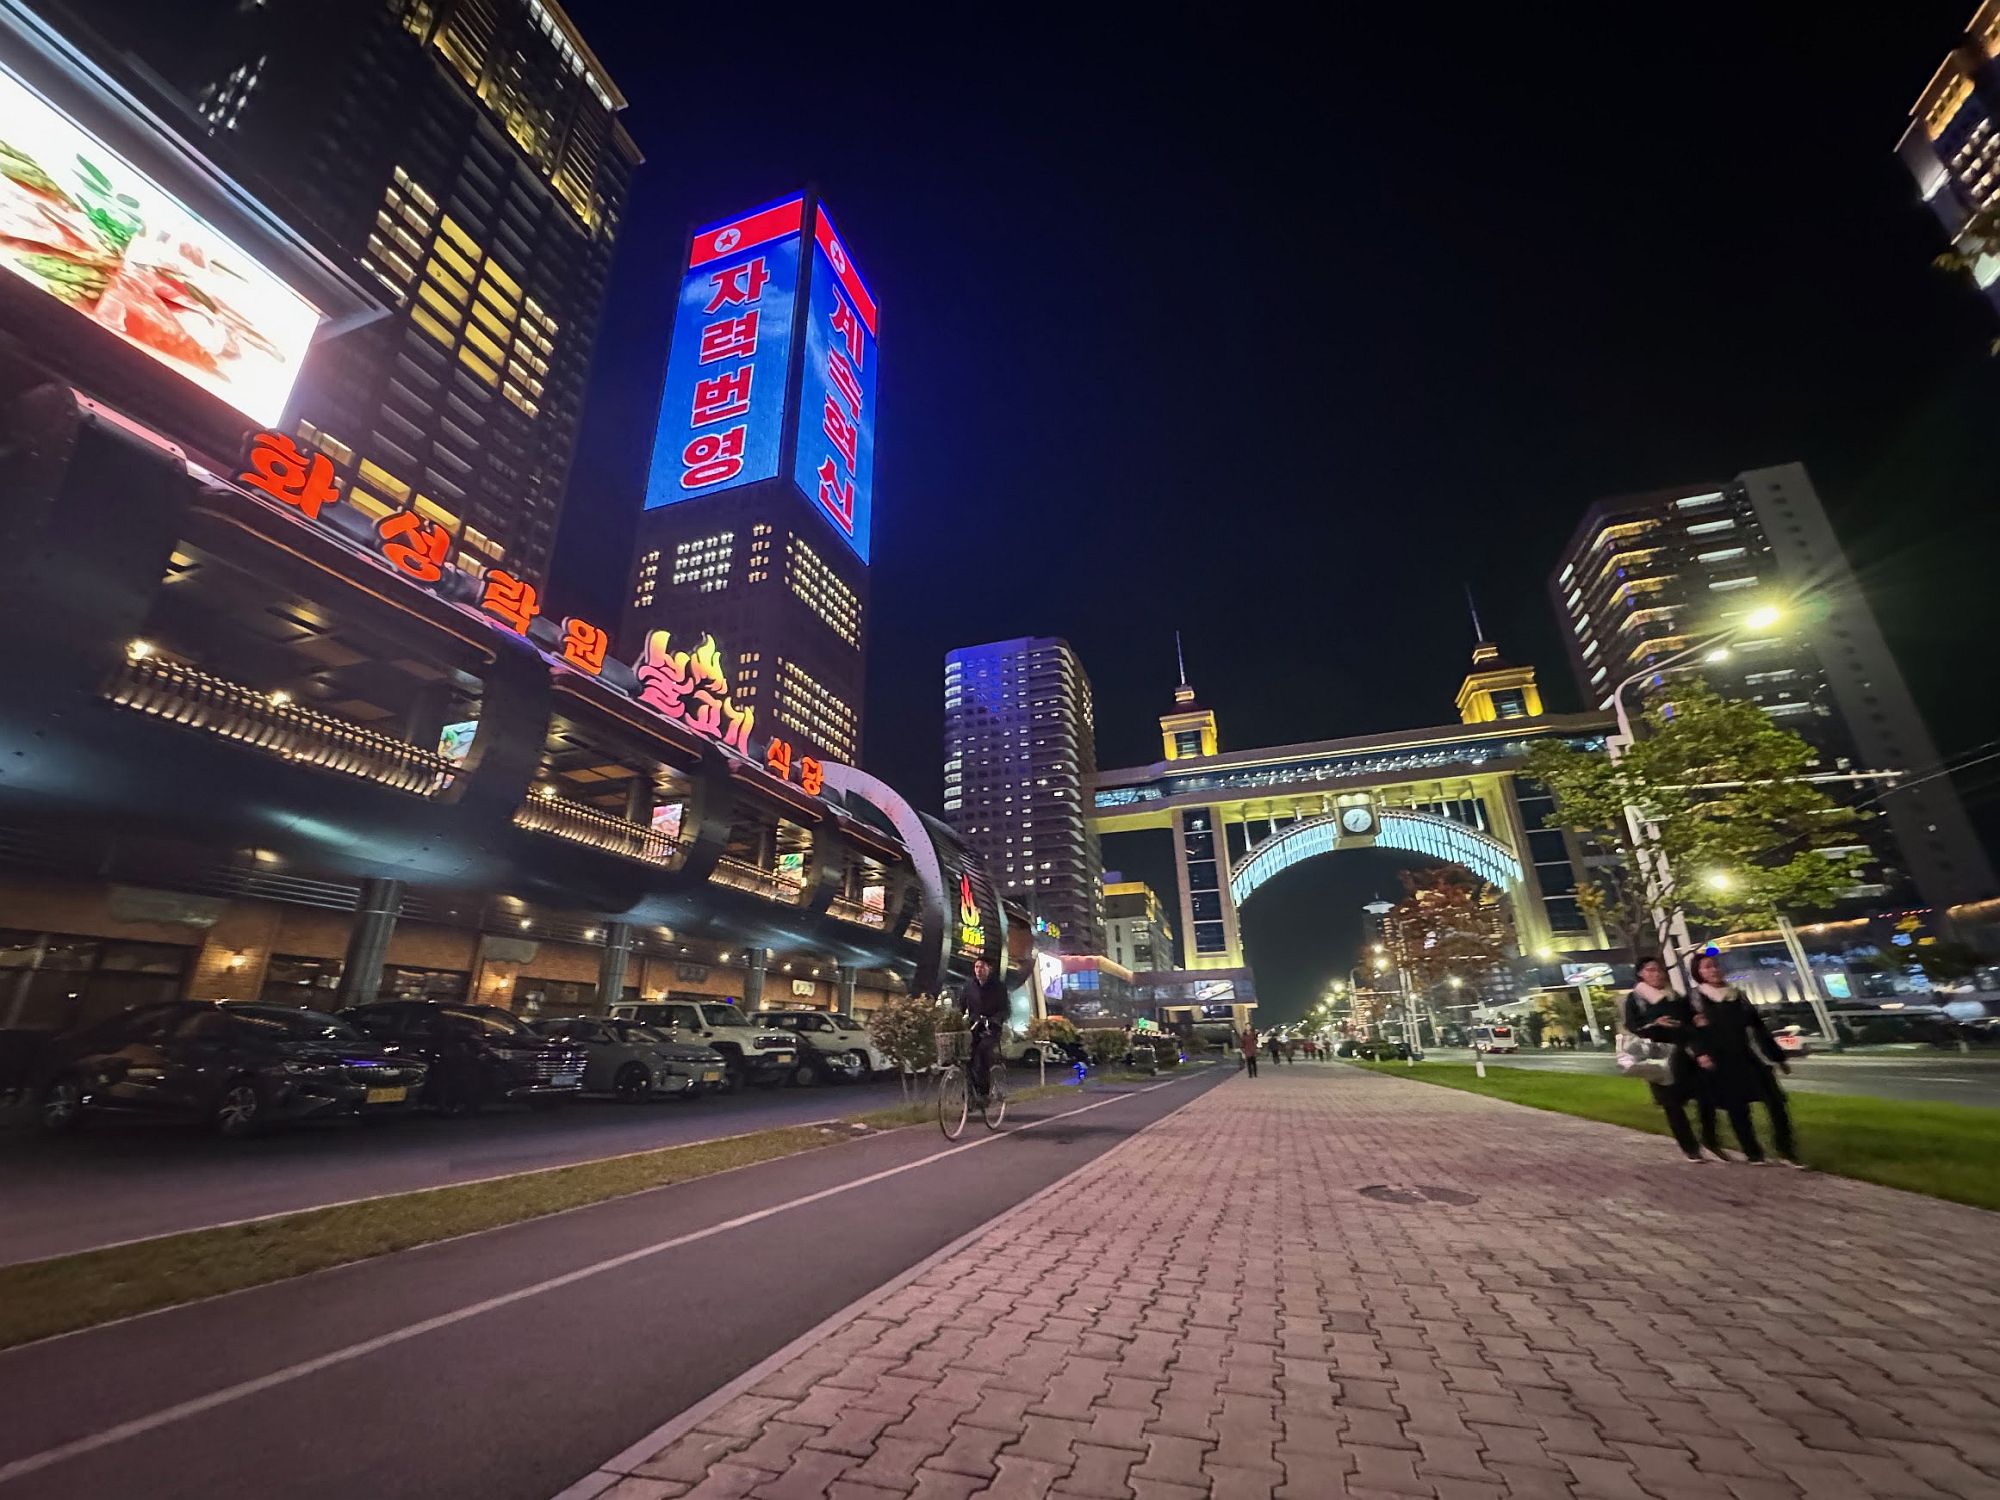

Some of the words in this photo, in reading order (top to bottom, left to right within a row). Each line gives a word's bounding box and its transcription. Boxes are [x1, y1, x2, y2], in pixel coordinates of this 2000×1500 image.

[680, 256, 770, 491] 자력번영
[817, 283, 864, 539] 계속혁신
[767, 737, 825, 796] 식당
